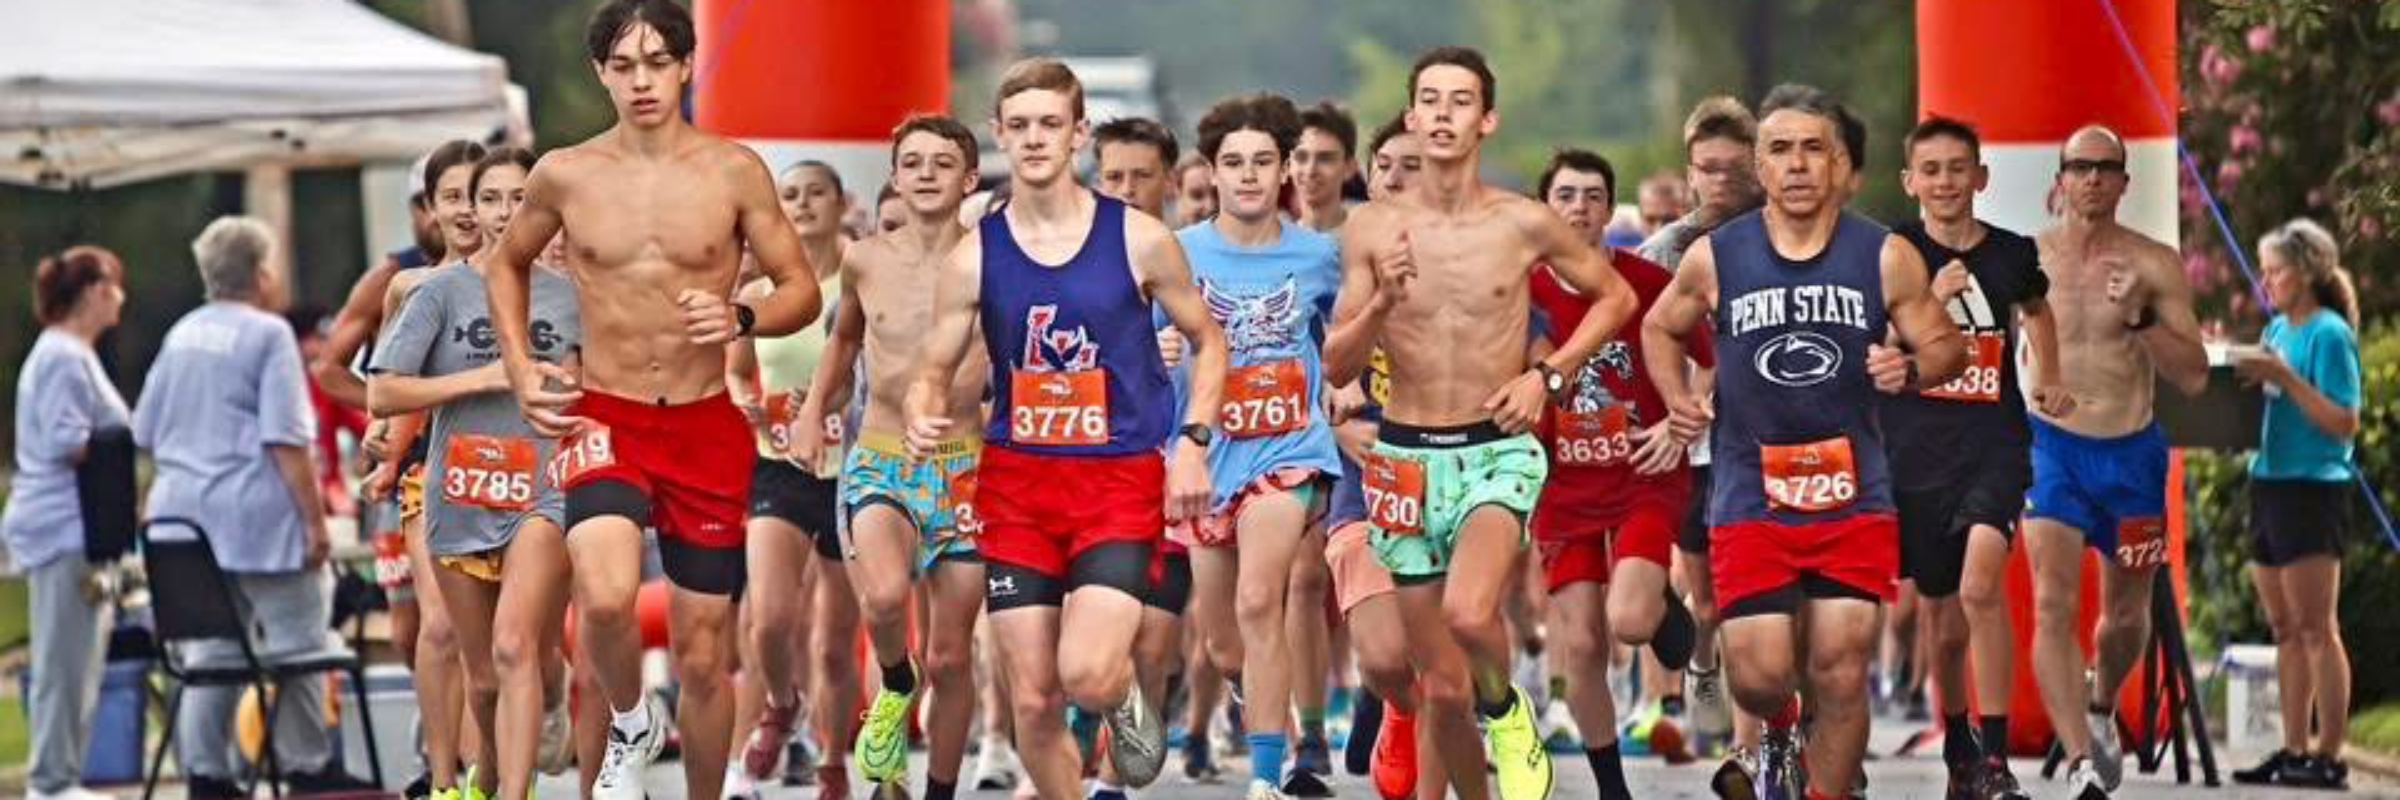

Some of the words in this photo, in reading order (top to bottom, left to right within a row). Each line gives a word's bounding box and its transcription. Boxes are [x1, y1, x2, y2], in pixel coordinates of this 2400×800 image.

[1730, 288, 1786, 336] PENN
[1794, 285, 1869, 331] STATE
[1015, 406, 1105, 438] 3776
[1222, 394, 1301, 432] 3761
[1556, 432, 1631, 463] 3633
[447, 467, 532, 503] 3785
[1764, 471, 1854, 507] 3726
[1364, 487, 1419, 527] 730
[2117, 538, 2168, 567] 372
